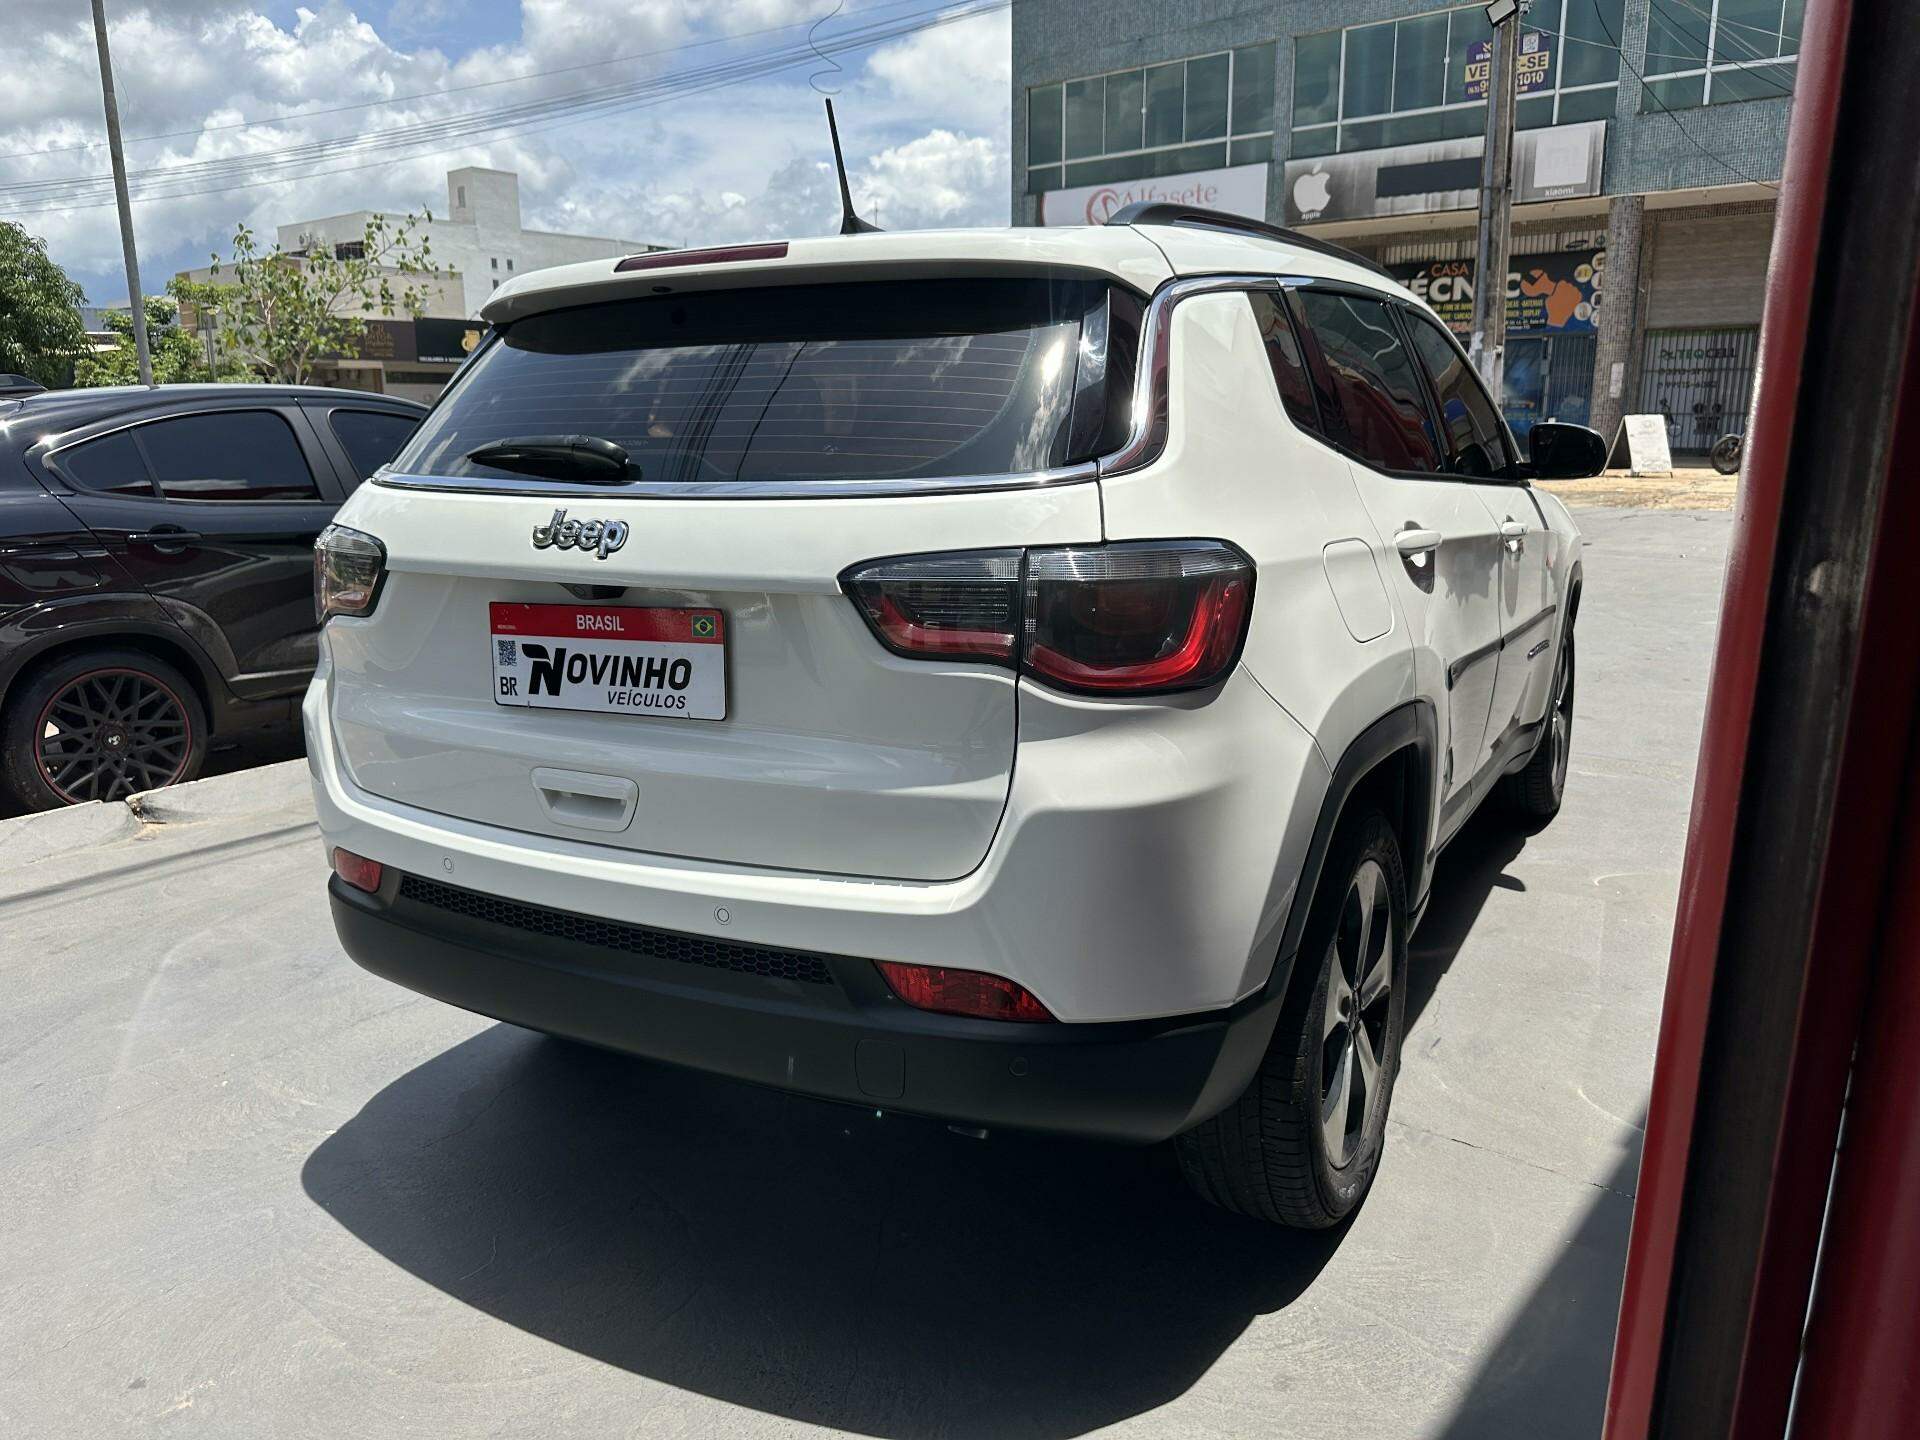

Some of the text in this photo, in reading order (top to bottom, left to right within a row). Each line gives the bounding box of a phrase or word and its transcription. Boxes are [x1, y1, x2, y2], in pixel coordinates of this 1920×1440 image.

[1431, 261, 1469, 277] CASA
[533, 508, 630, 560] Jeep
[576, 614, 624, 631] BRASIL
[500, 643, 692, 696] BR NOVINHO
[607, 689, 686, 709] VEÍCULOS
